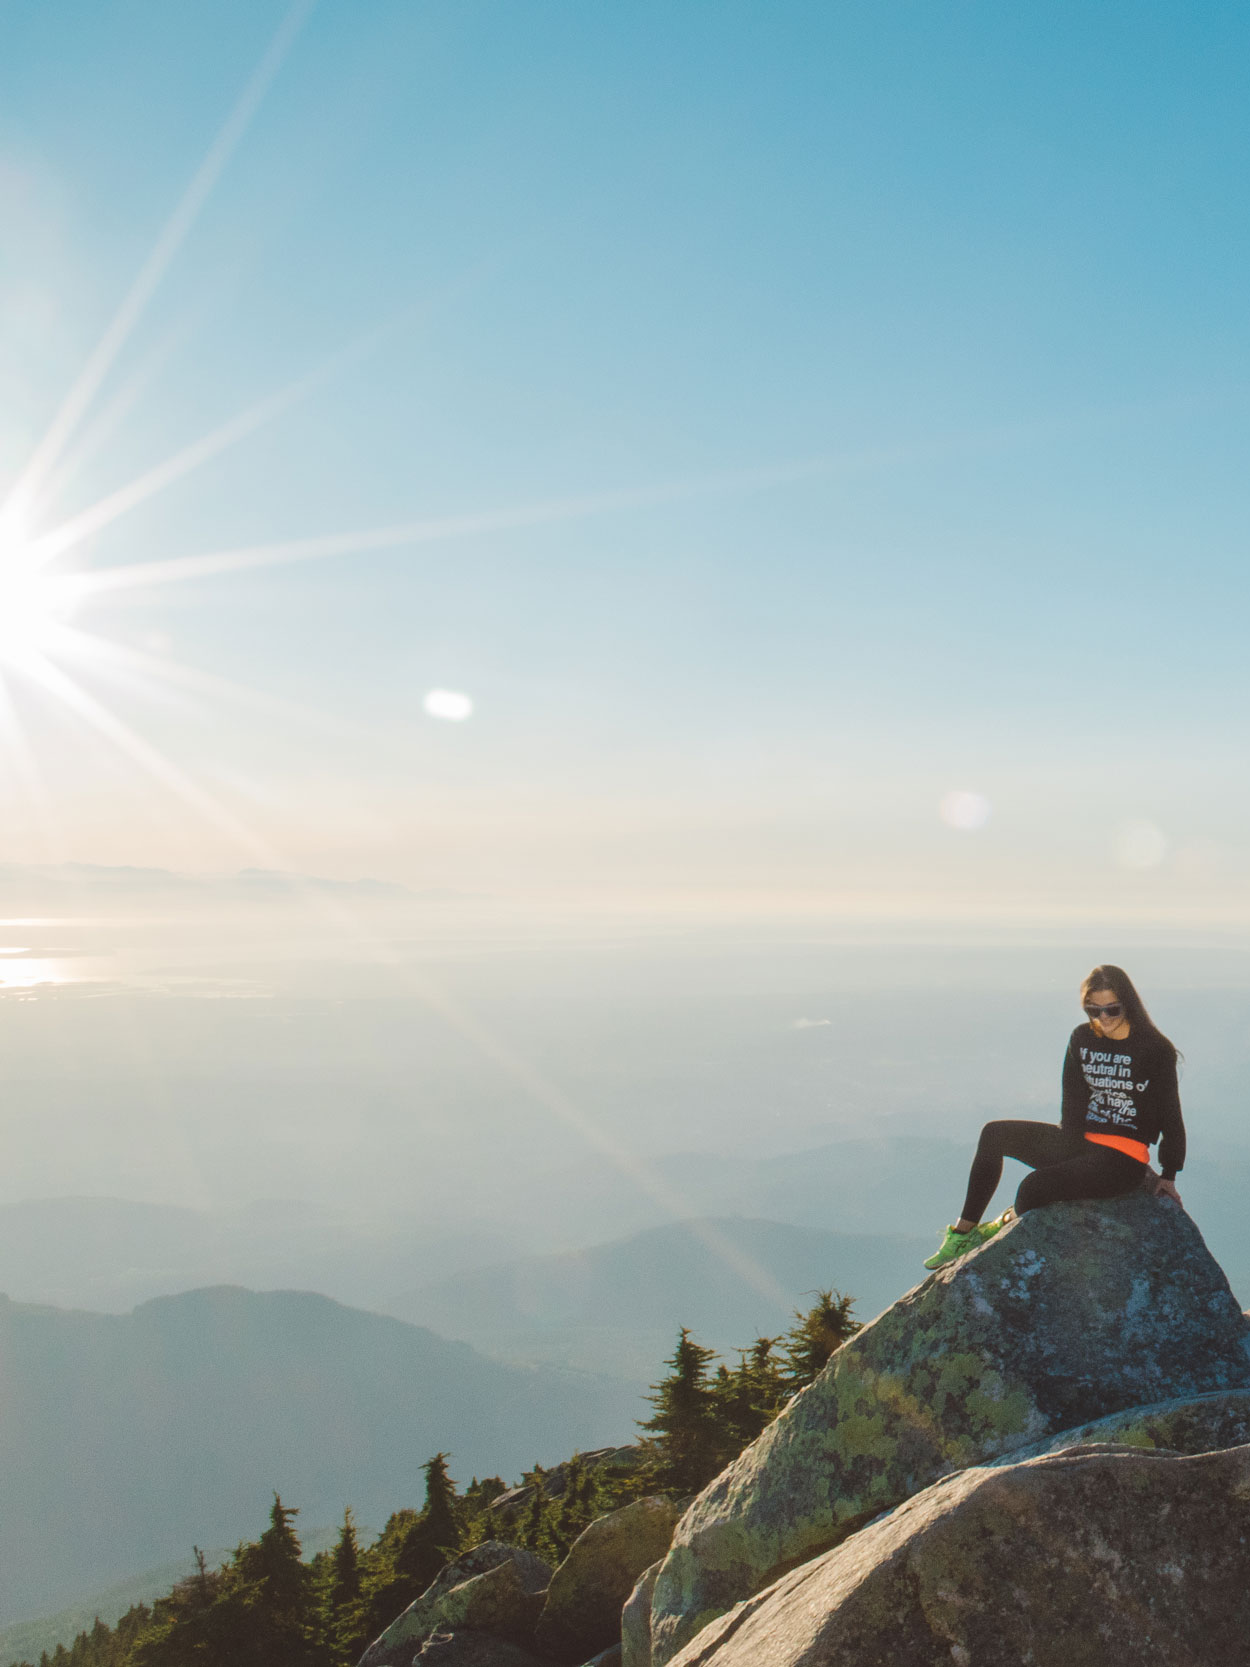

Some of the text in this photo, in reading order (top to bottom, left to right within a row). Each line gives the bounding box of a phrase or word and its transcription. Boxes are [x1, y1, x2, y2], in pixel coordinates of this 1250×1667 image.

[1090, 1051, 1111, 1064] you
[1113, 1054, 1131, 1065] are
[1118, 1065, 1131, 1078] in
[1084, 1074, 1133, 1090] ituations
